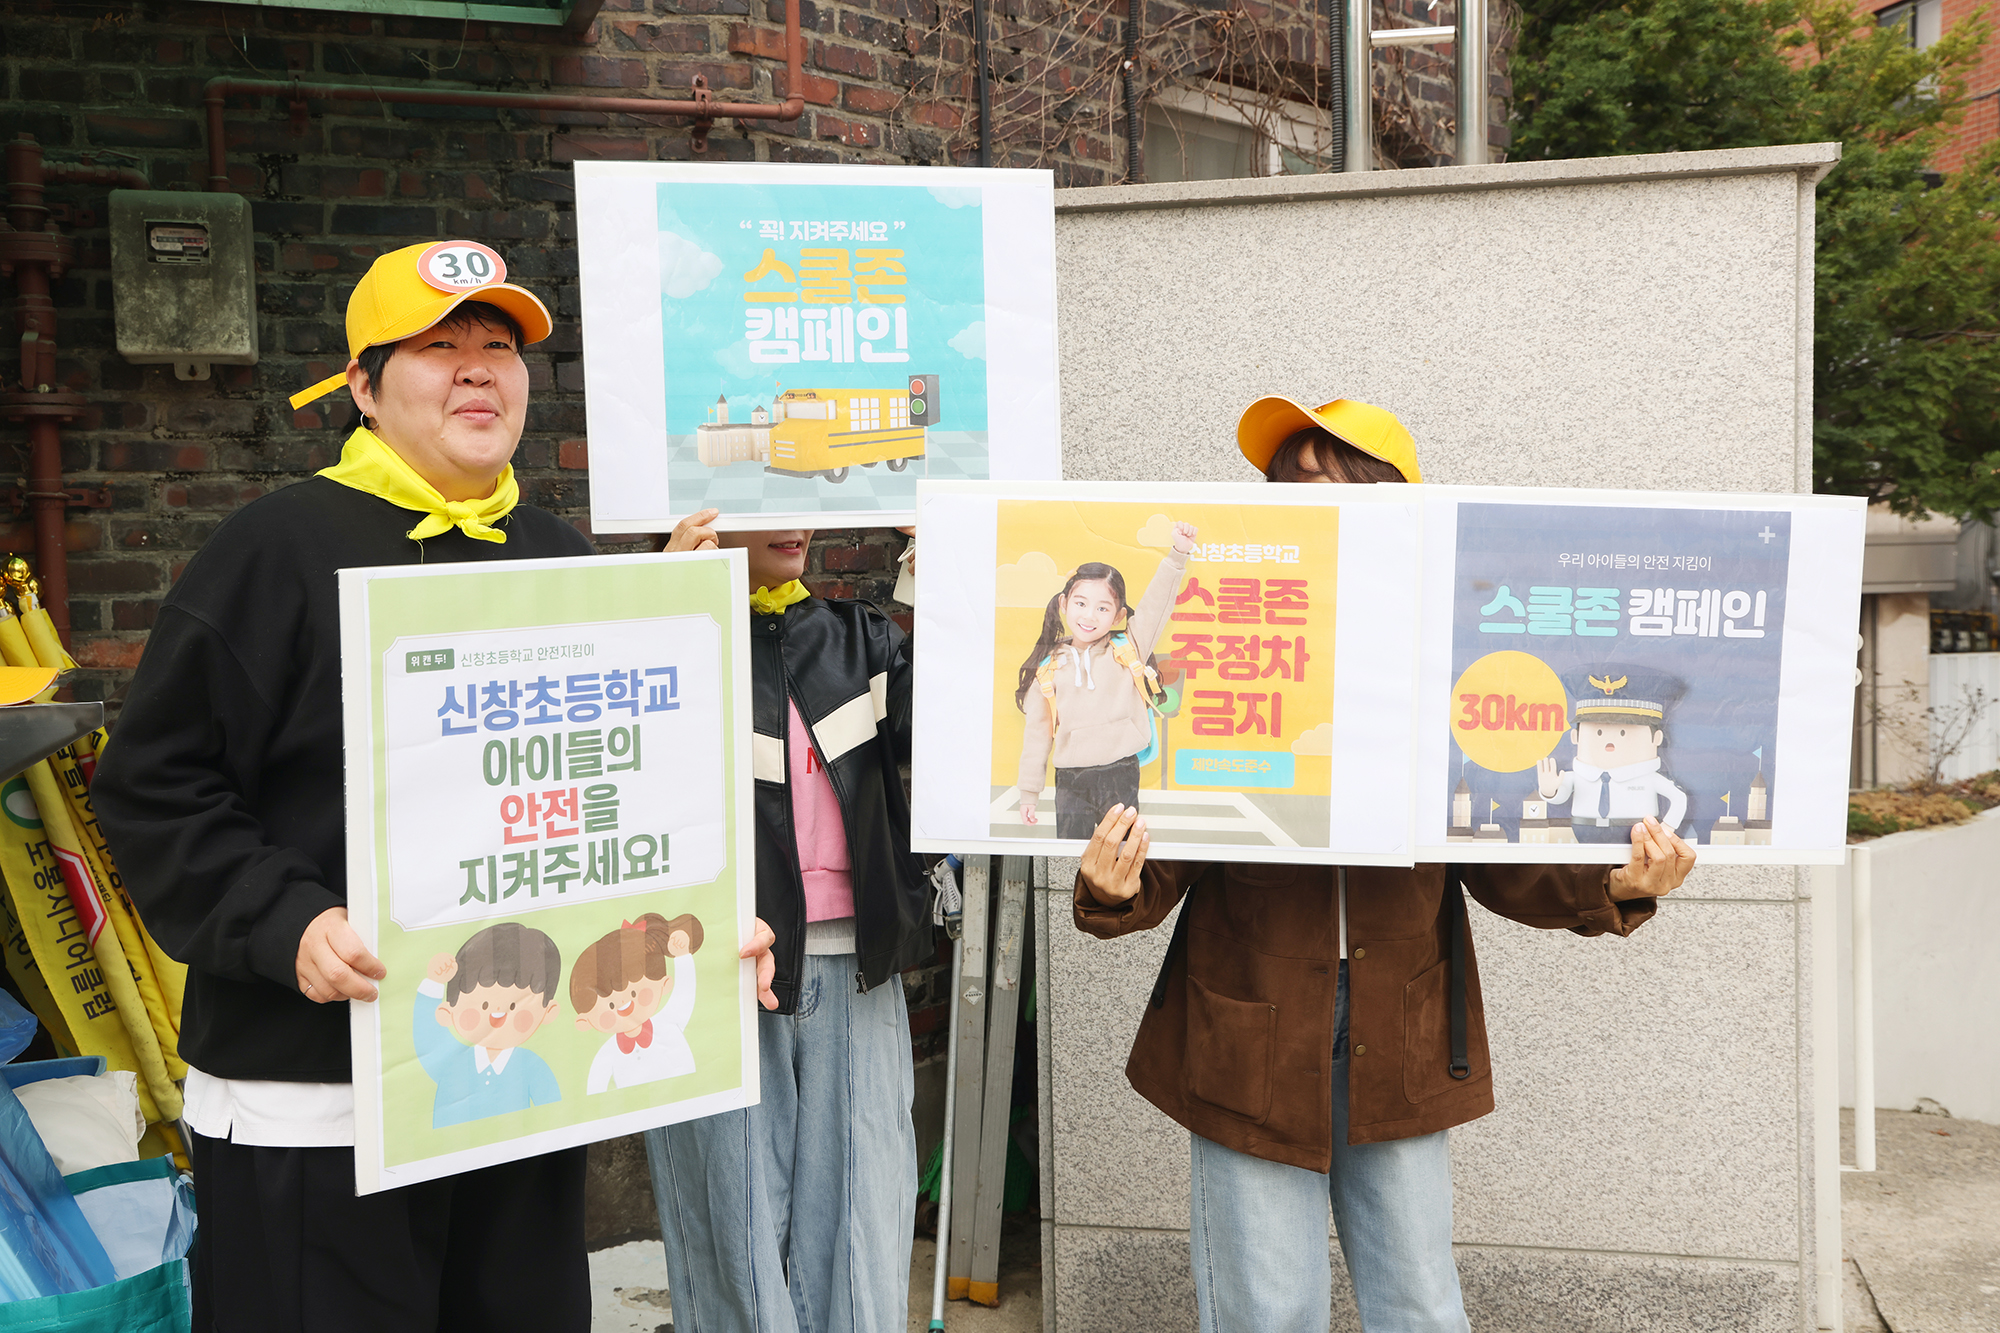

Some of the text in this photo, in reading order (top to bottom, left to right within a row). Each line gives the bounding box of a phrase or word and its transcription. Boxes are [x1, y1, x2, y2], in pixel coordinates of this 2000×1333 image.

[759, 220, 785, 241] 꼭!
[789, 220, 889, 242] 지켜주세요
[437, 251, 490, 278] 30
[453, 277, 482, 285] km/h
[743, 248, 907, 304] 스쿨존
[744, 306, 910, 363] 캠페인
[1190, 543, 1300, 564] 신창초등학교
[1558, 553, 1712, 571] 우리 아이들의 안전 지킴이
[1170, 577, 1310, 626] 스쿨존
[1479, 585, 1767, 639] 스쿨존 캠페인
[461, 643, 595, 667] 신창초등학교 안전지킴이
[1169, 633, 1311, 682] 주정차
[437, 666, 681, 736] 신창초등학교
[1190, 690, 1282, 738] 금지
[1457, 693, 1565, 732] 30km
[482, 724, 642, 787] 아이들의
[1191, 757, 1272, 774] 제한속도준수
[500, 783, 621, 845] 안전을
[459, 834, 670, 906] 지켜주세요!
